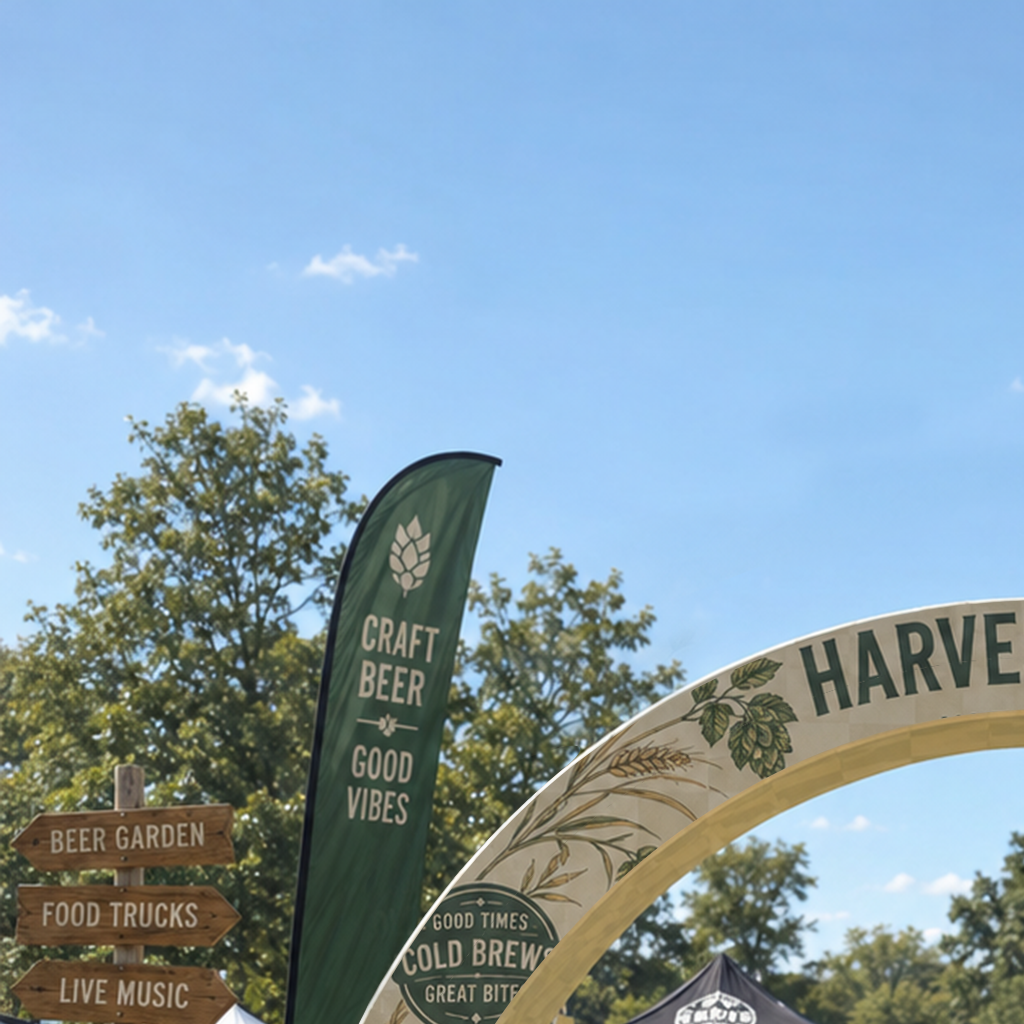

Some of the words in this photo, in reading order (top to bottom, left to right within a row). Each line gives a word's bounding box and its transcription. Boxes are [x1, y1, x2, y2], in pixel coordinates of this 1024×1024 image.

[361, 613, 440, 663] CRAFT
[357, 659, 425, 707] BEER
[351, 744, 413, 784] GOOD
[347, 785, 410, 826] VIBES
[50, 827, 106, 854] BEER
[115, 821, 204, 850] GARDEN
[42, 901, 101, 927] FOOD
[109, 901, 199, 928] TRUCKS
[432, 911, 474, 931] GOOD
[480, 911, 529, 931] TIMES
[402, 939, 463, 976] COLD
[59, 977, 108, 1005] LIVE
[117, 979, 190, 1009] MUSIC
[424, 984, 478, 1003] GREAT
[483, 983, 523, 1003] BITE
